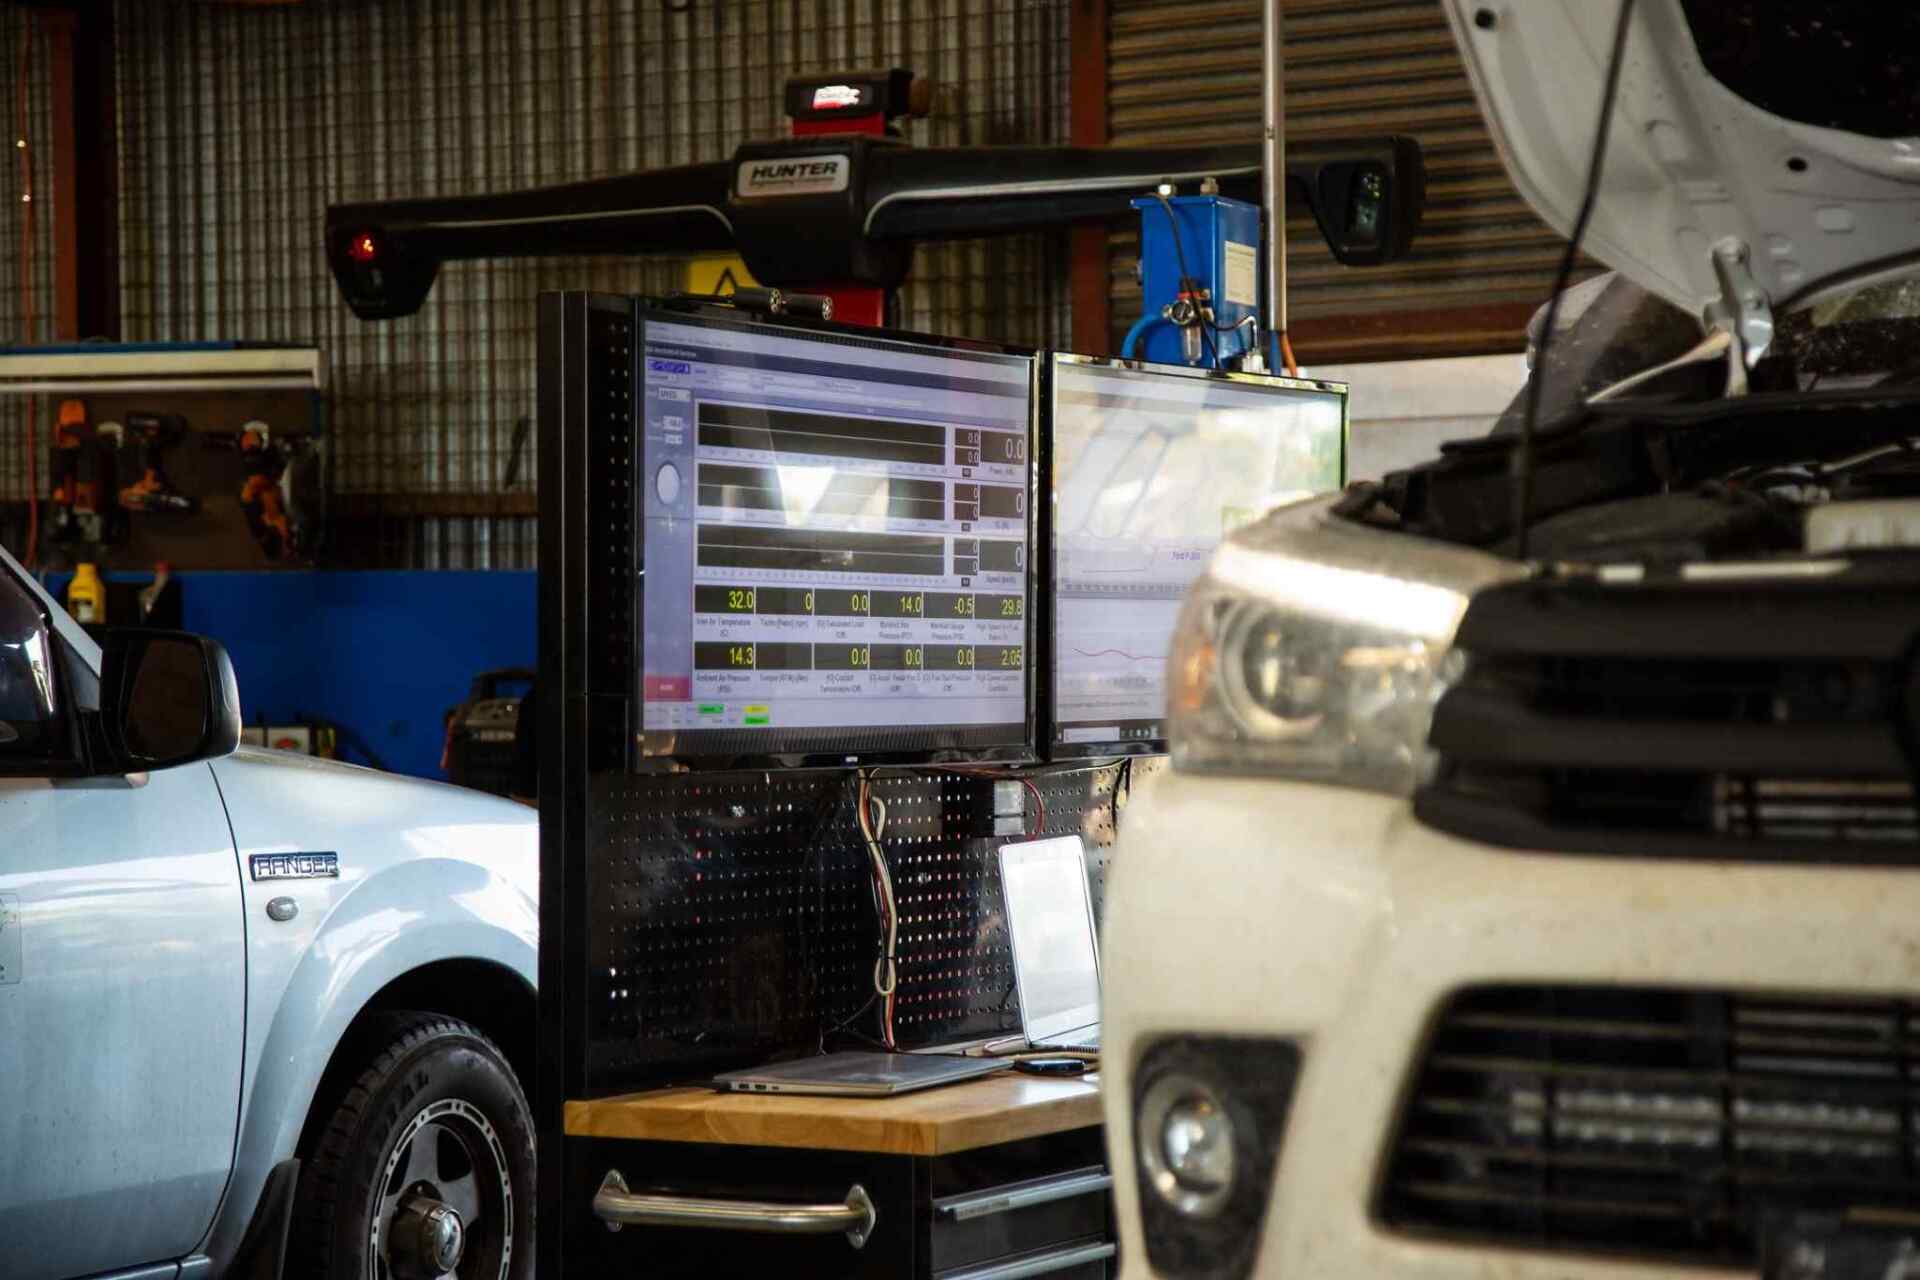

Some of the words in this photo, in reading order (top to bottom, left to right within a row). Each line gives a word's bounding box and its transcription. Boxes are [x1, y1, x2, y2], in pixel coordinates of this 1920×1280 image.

[751, 161, 838, 178] HUNTER
[1005, 438, 1024, 459] 0.0
[1016, 492, 1023, 513] 0
[1015, 546, 1023, 567] 0
[728, 590, 754, 609] 32.0
[805, 592, 812, 610] 0
[851, 594, 868, 611] 0.0
[901, 597, 921, 613] 14.0
[954, 598, 973, 614] -0.5
[729, 647, 753, 665] 14.3
[851, 648, 868, 665] 0.0
[905, 649, 921, 665] 0.0
[958, 649, 973, 666] 0.0
[256, 855, 337, 876] RANGER
